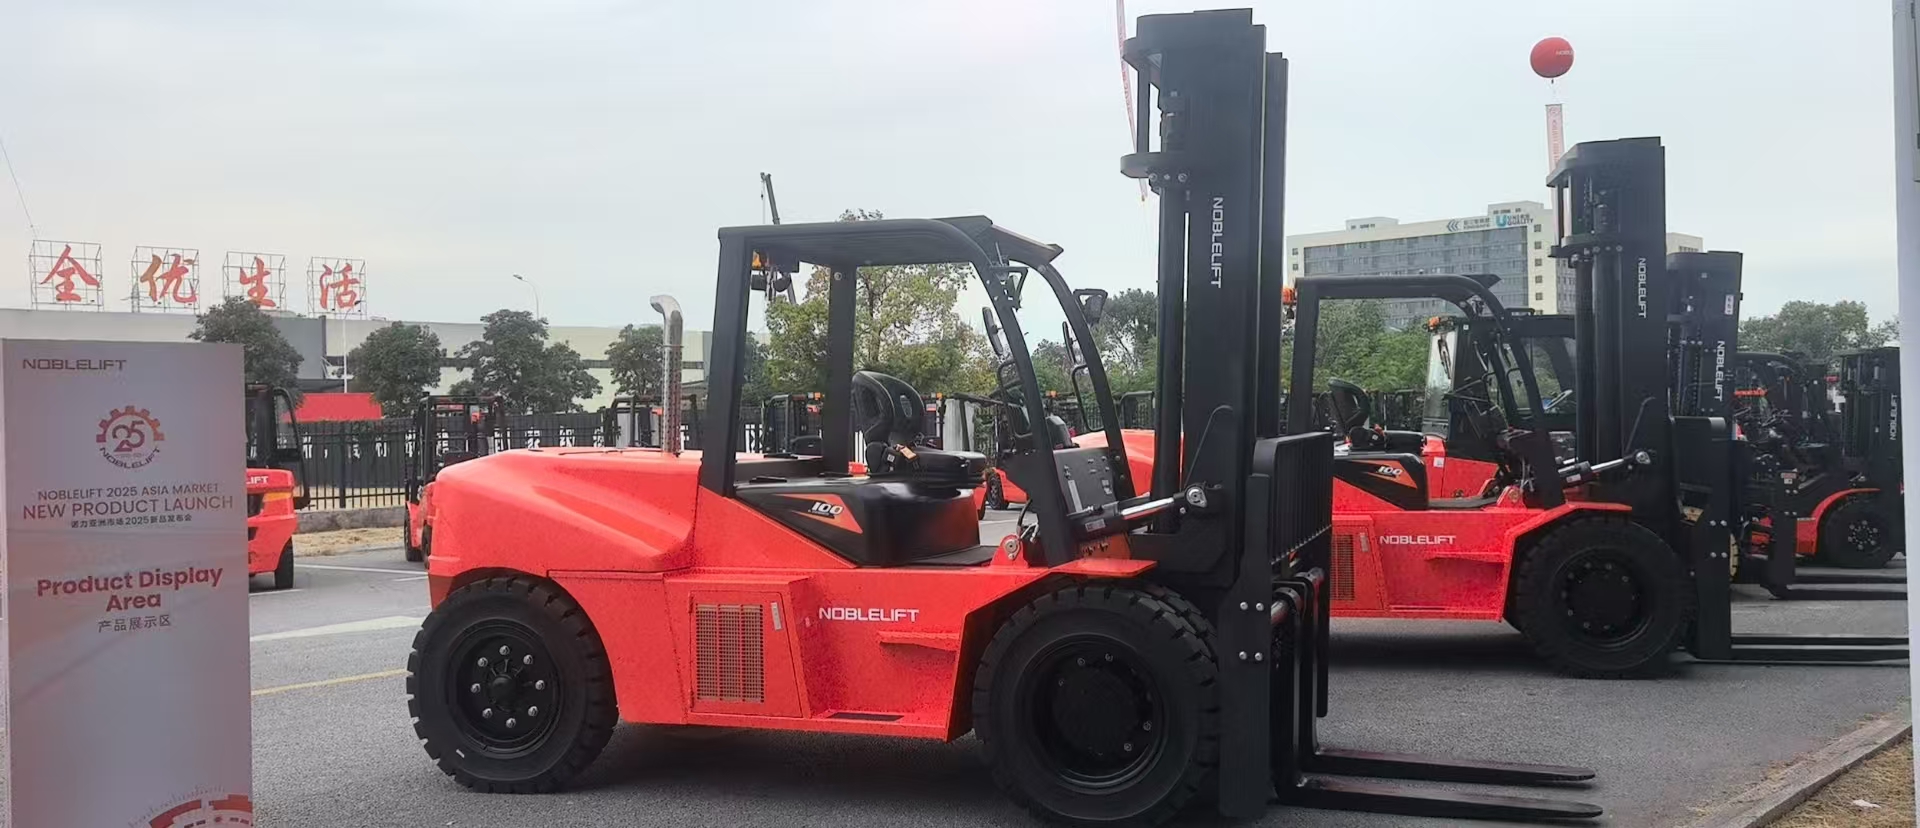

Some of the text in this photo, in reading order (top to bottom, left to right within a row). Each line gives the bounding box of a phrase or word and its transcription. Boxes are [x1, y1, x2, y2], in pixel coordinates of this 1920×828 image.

[1210, 197, 1223, 288] NOBLELIFT
[41, 245, 361, 309] 全优生活
[1637, 257, 1647, 319] NOBLELIFT
[22, 359, 127, 372] NOBLELIFT
[1714, 340, 1725, 402] NOBLELIFT
[1889, 393, 1898, 440] NOBLELIFT
[112, 420, 145, 452] 25
[99, 446, 160, 469] NOBLELIFT
[1378, 465, 1402, 475] 100
[38, 483, 218, 501] NOBLELIFT 2025 ASIA MARKET
[23, 495, 233, 520] NEW PRODUCT LAUNCH
[811, 501, 844, 516] 100
[1379, 535, 1457, 545] NOBLELIFT
[37, 566, 223, 597] Product Display
[106, 593, 162, 613] Area
[818, 607, 920, 622] NOBLELIFT
[98, 614, 171, 633] 产品展示区
